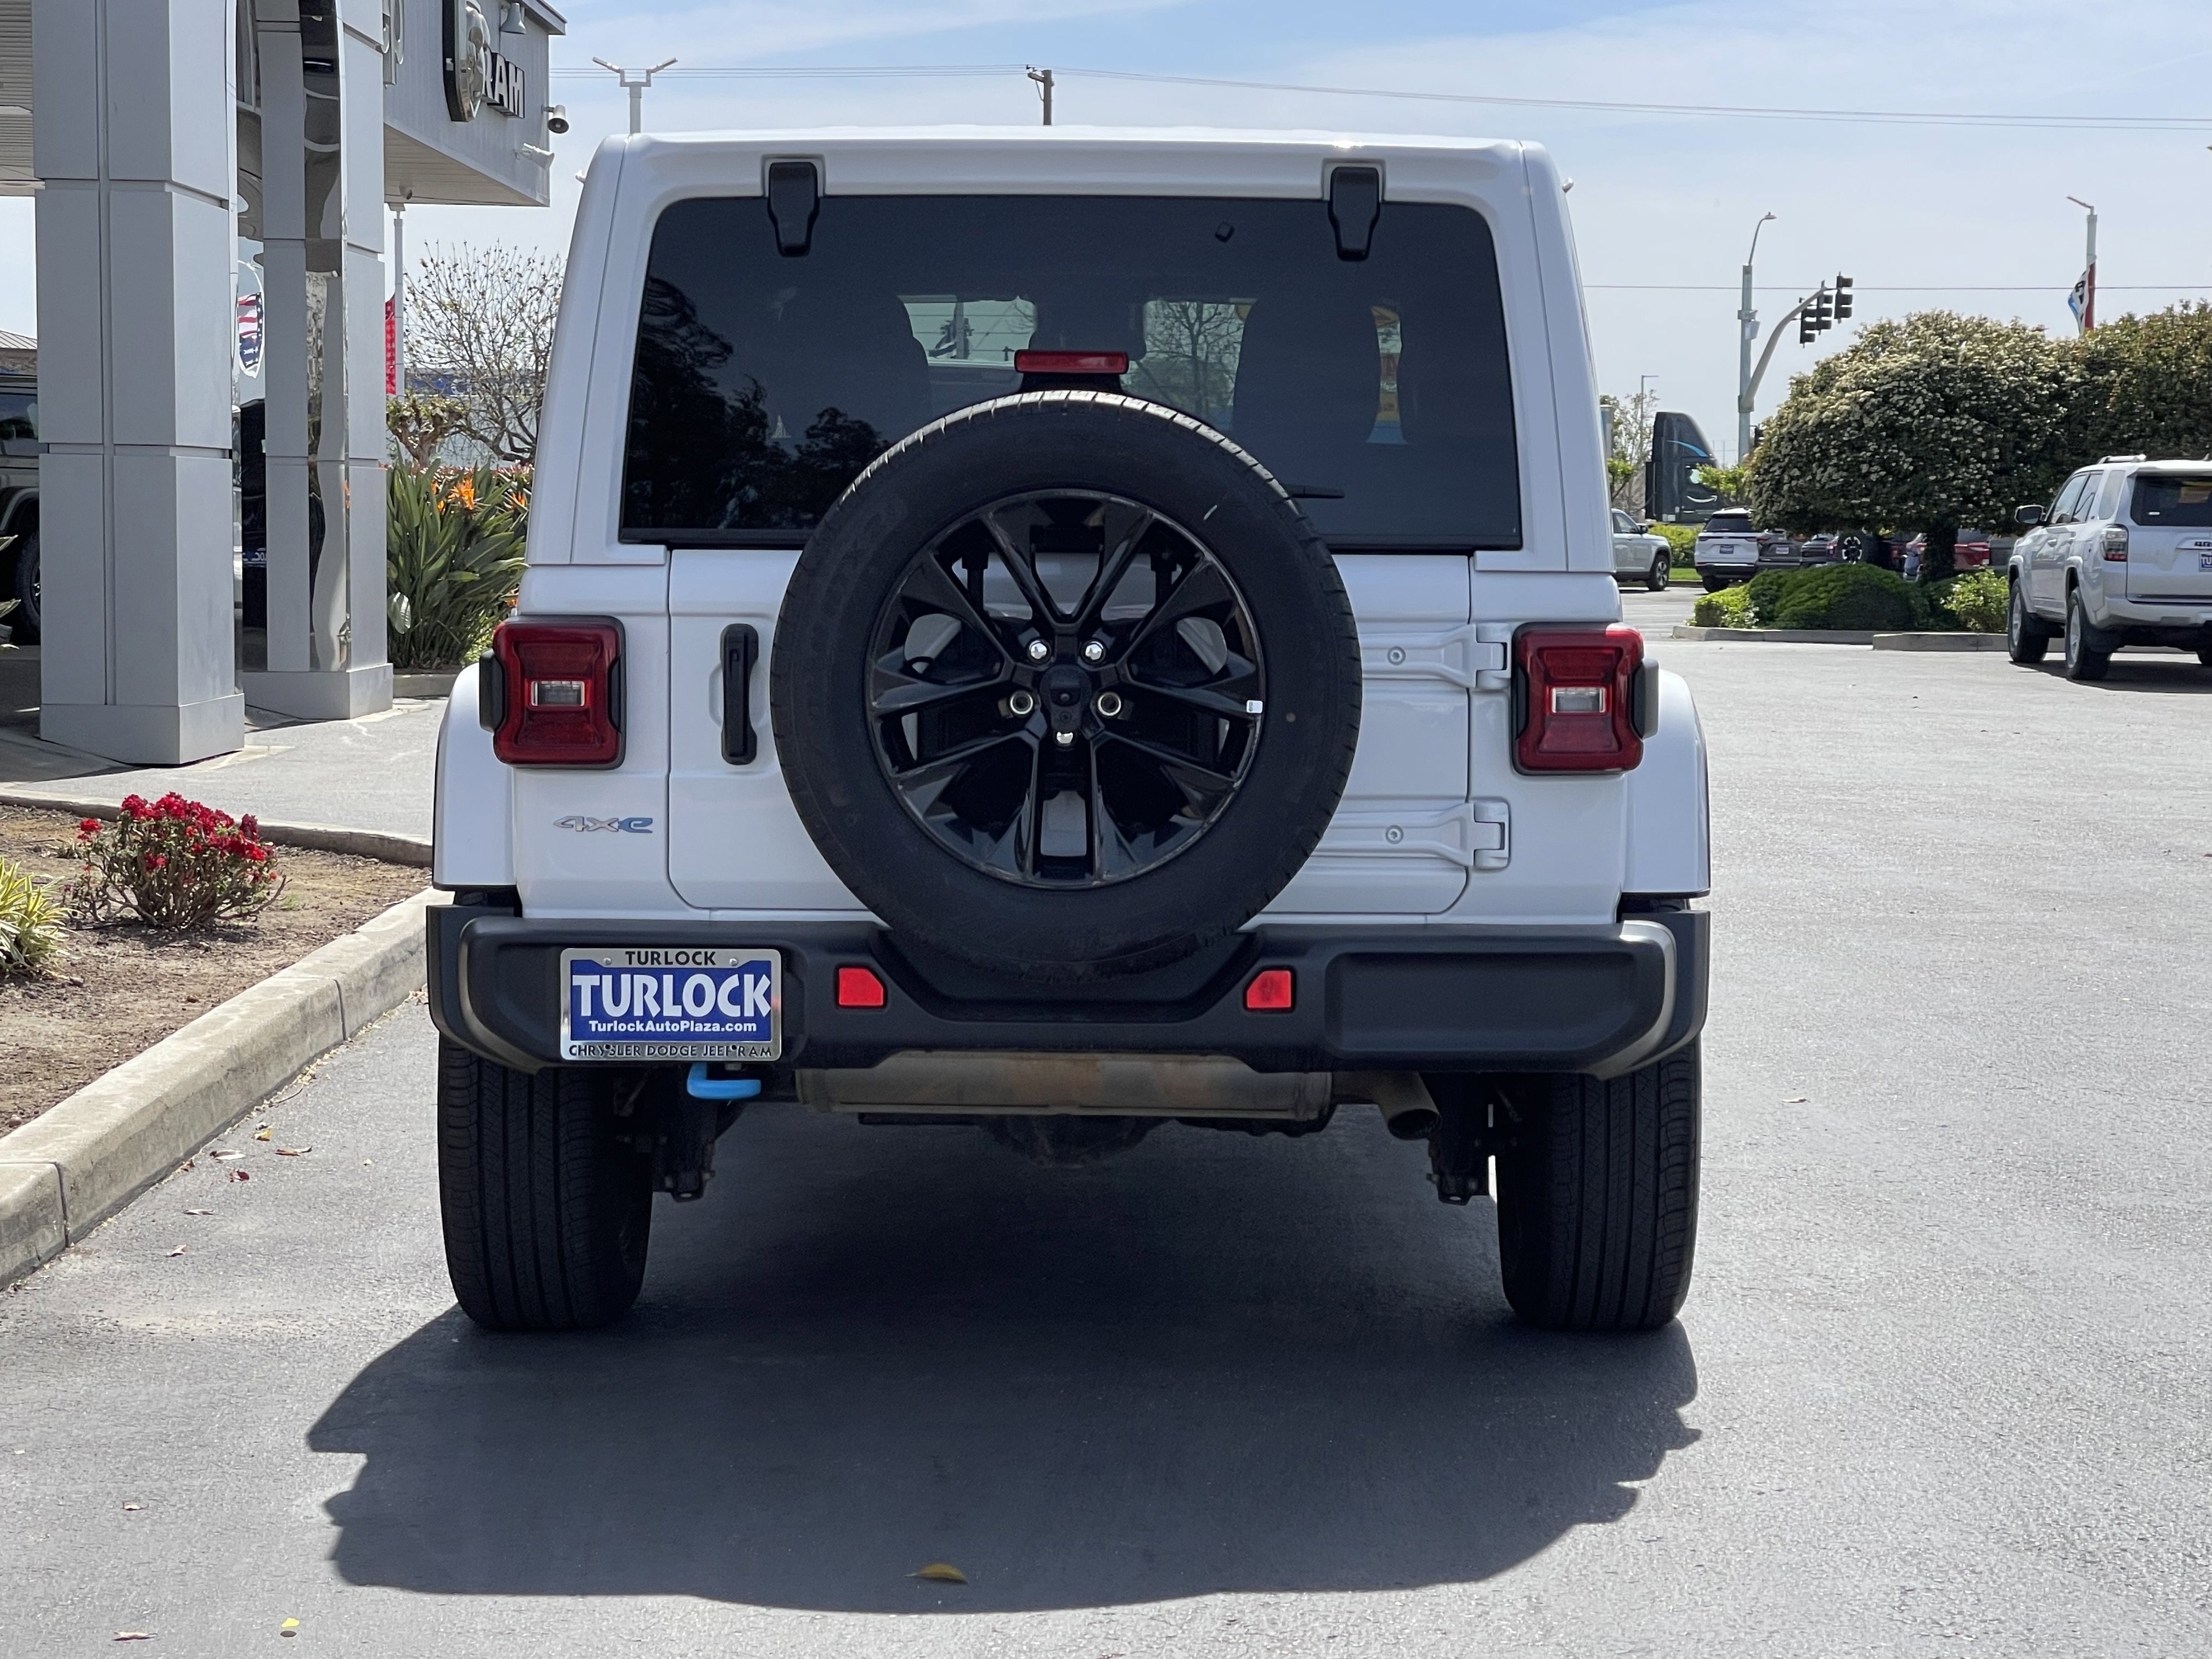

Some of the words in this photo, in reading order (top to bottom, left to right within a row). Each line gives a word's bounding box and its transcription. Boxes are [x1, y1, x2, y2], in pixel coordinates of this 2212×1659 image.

[625, 951, 716, 966] TURLOCK
[572, 973, 771, 1018] TURLOCK
[589, 1020, 757, 1032] TurlockAutoPlaza.com
[569, 1045, 641, 1057] CHRYSLER
[647, 1045, 697, 1057] DODGE
[737, 1045, 772, 1057] RAM
